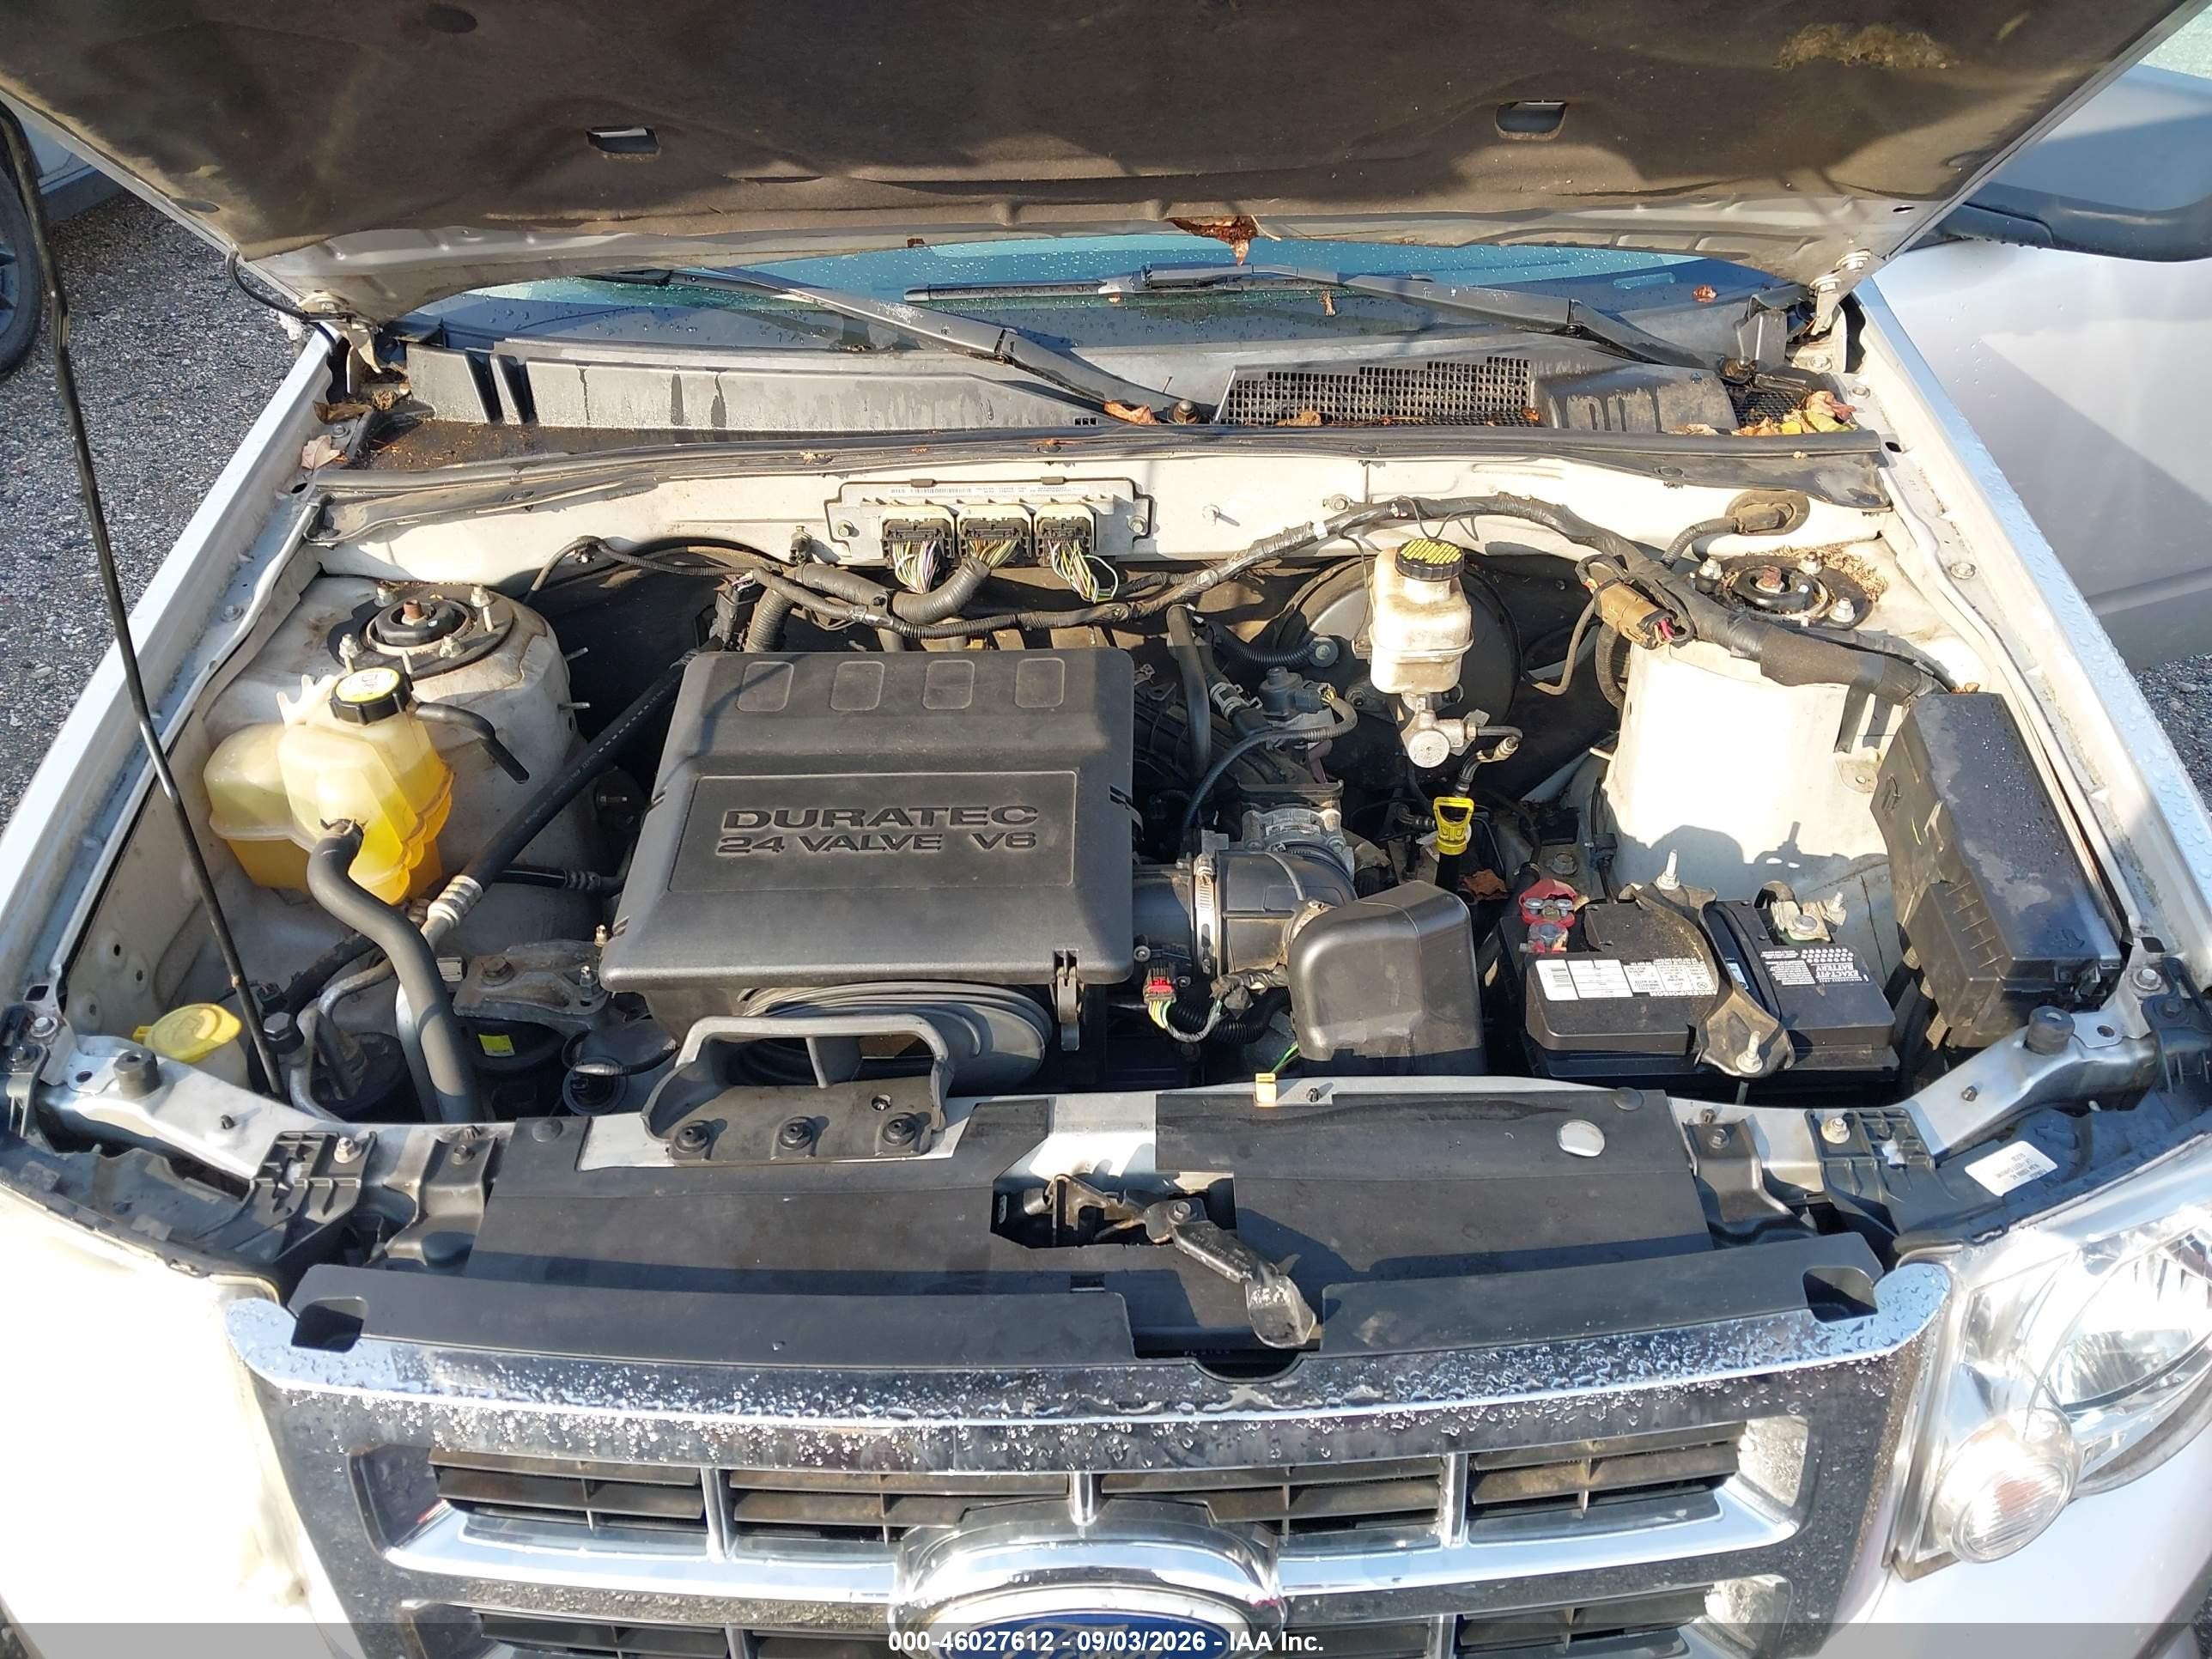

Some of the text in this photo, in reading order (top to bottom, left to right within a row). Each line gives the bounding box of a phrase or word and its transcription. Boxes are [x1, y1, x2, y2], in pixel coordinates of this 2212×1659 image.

[722, 805, 1038, 829] DURATEC
[716, 831, 1038, 854] 24 VALVE V6
[1815, 963, 1854, 972] BATTERY
